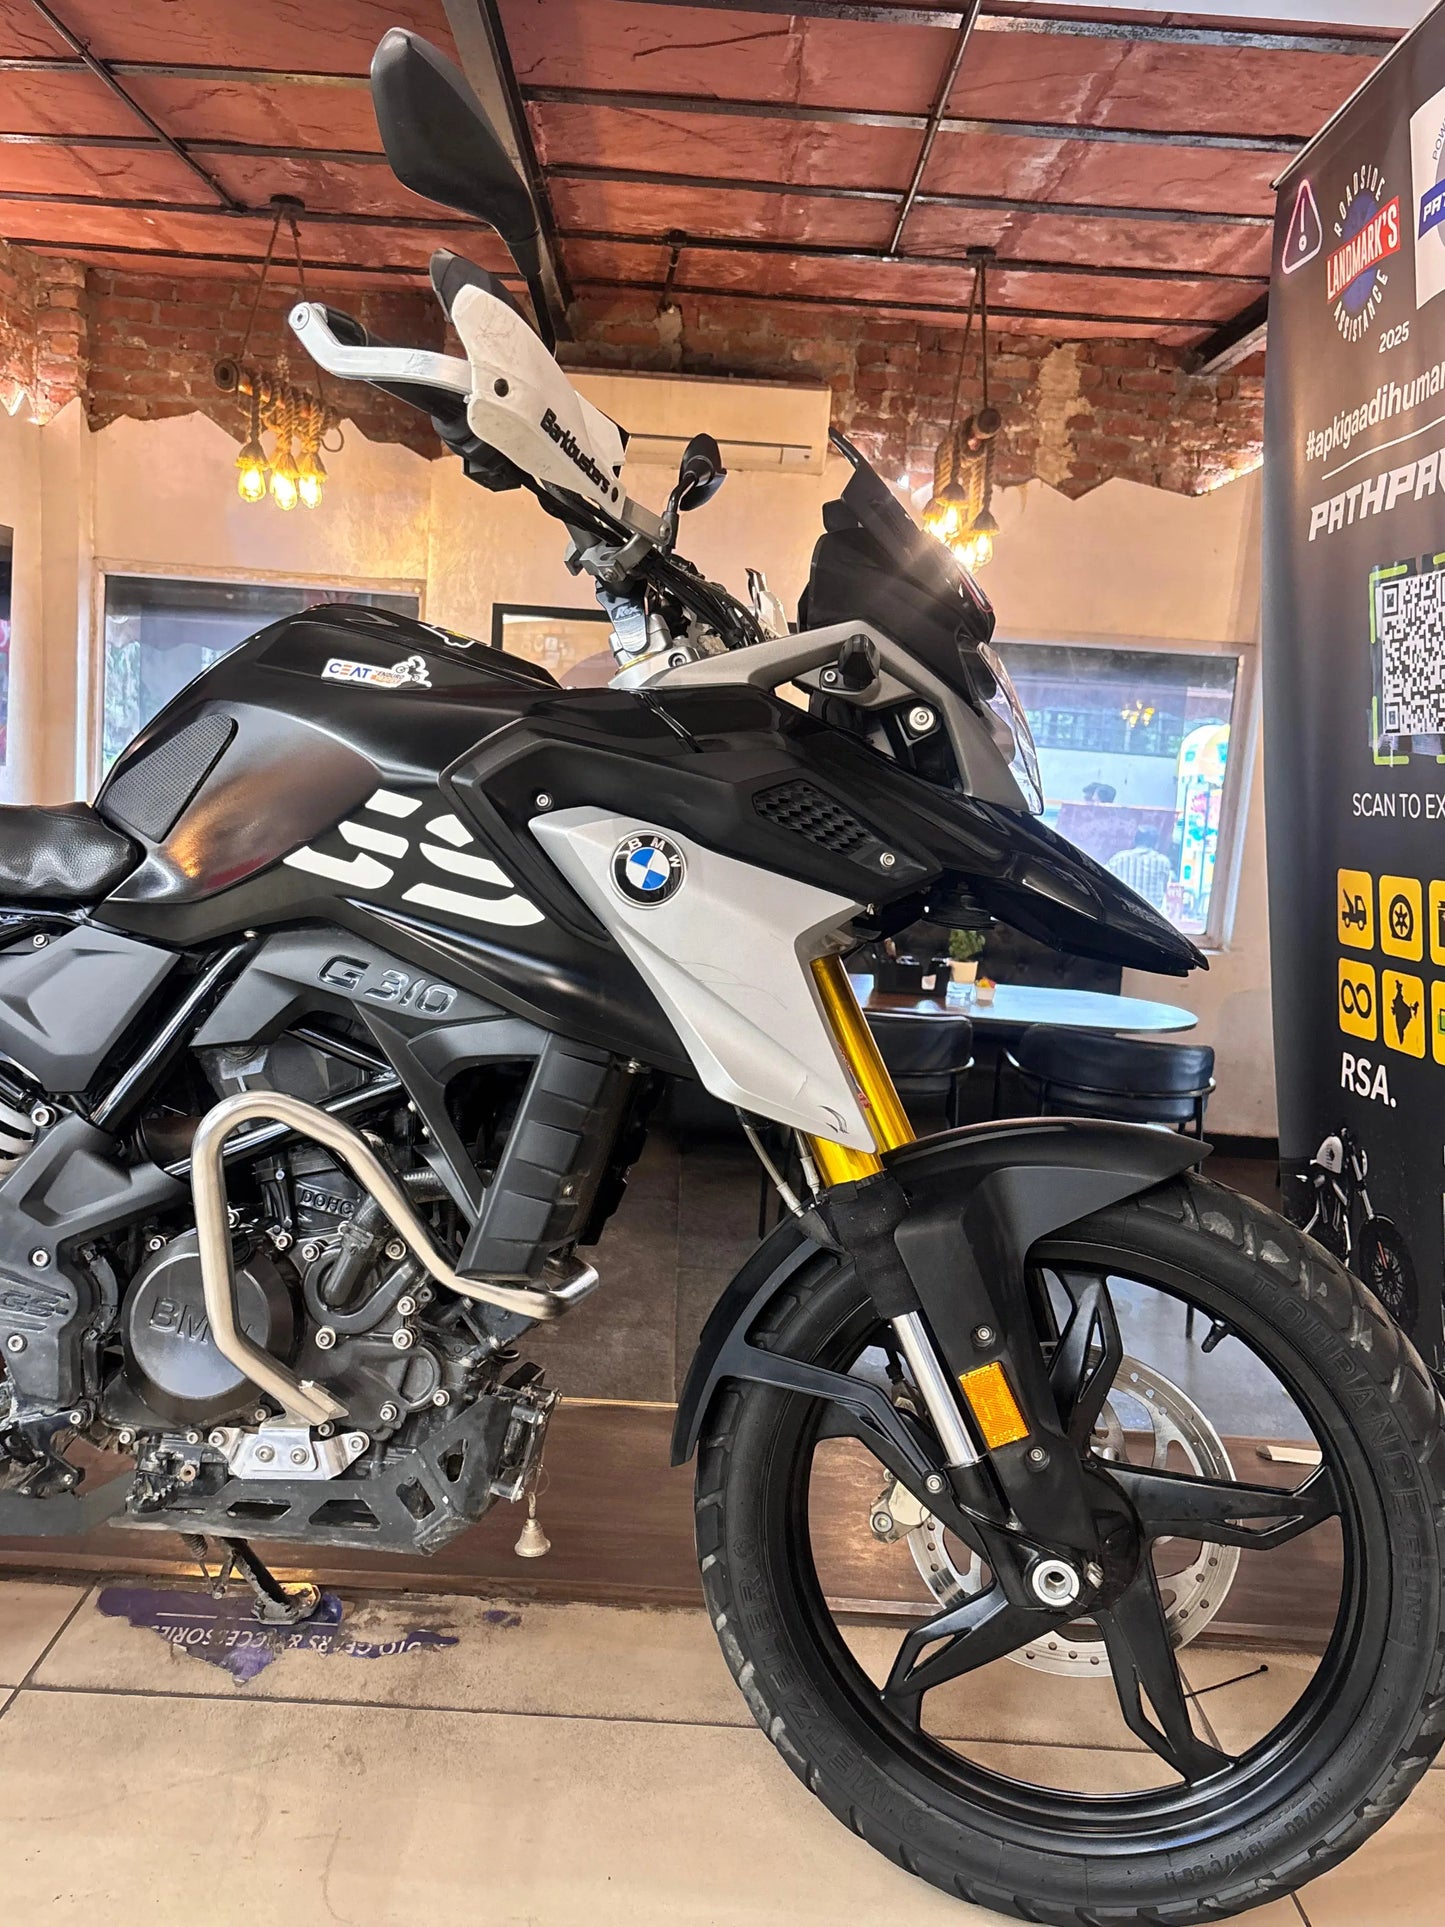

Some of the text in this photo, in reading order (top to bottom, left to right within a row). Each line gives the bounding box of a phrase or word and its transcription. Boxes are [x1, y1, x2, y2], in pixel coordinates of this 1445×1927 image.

[1333, 164, 1386, 237] ROADSIDE
[1327, 203, 1398, 300] LANDMARK'S
[1333, 269, 1388, 342] ASSISTANCE
[1378, 320, 1410, 353] 2025
[540, 408, 610, 494] Barkbusters
[329, 663, 372, 679] CEAT
[1352, 792, 1396, 817] SCAN
[1399, 793, 1421, 819] TO
[628, 837, 681, 868] BMW
[317, 954, 458, 1016] G 310
[1340, 1051, 1397, 1108] RSA.
[301, 1189, 356, 1217] DOHC
